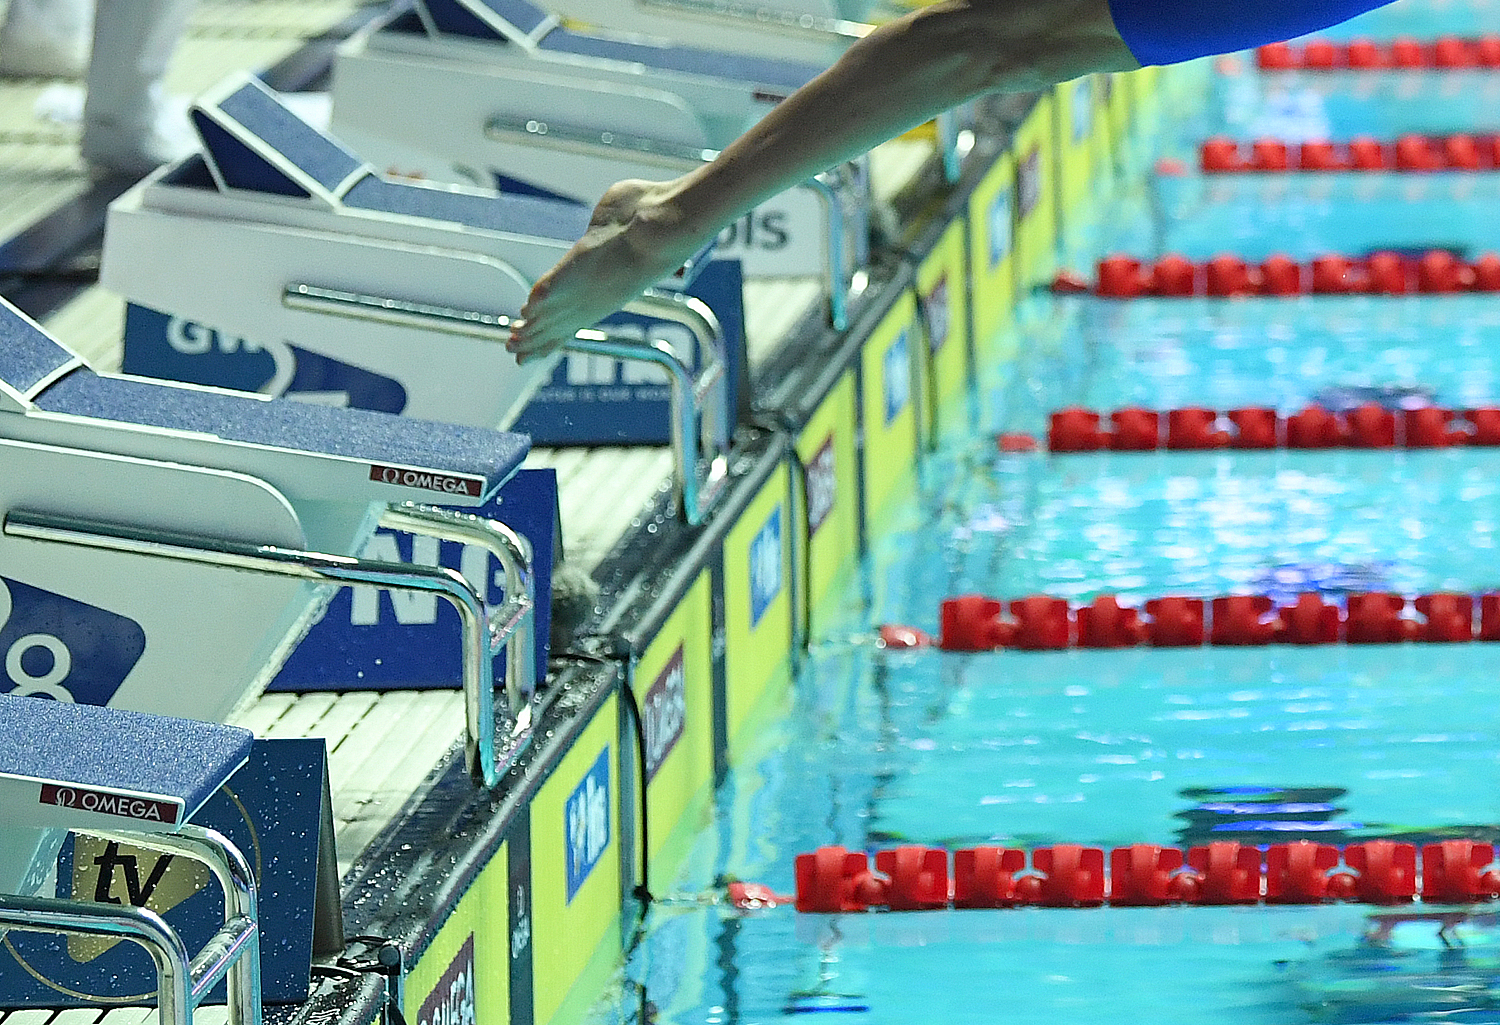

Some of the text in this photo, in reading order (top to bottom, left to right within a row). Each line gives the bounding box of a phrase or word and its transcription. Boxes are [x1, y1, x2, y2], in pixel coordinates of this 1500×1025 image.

[403, 470, 470, 495] OMEGA
[82, 792, 162, 821] OMEGA
[93, 839, 175, 908] tv
